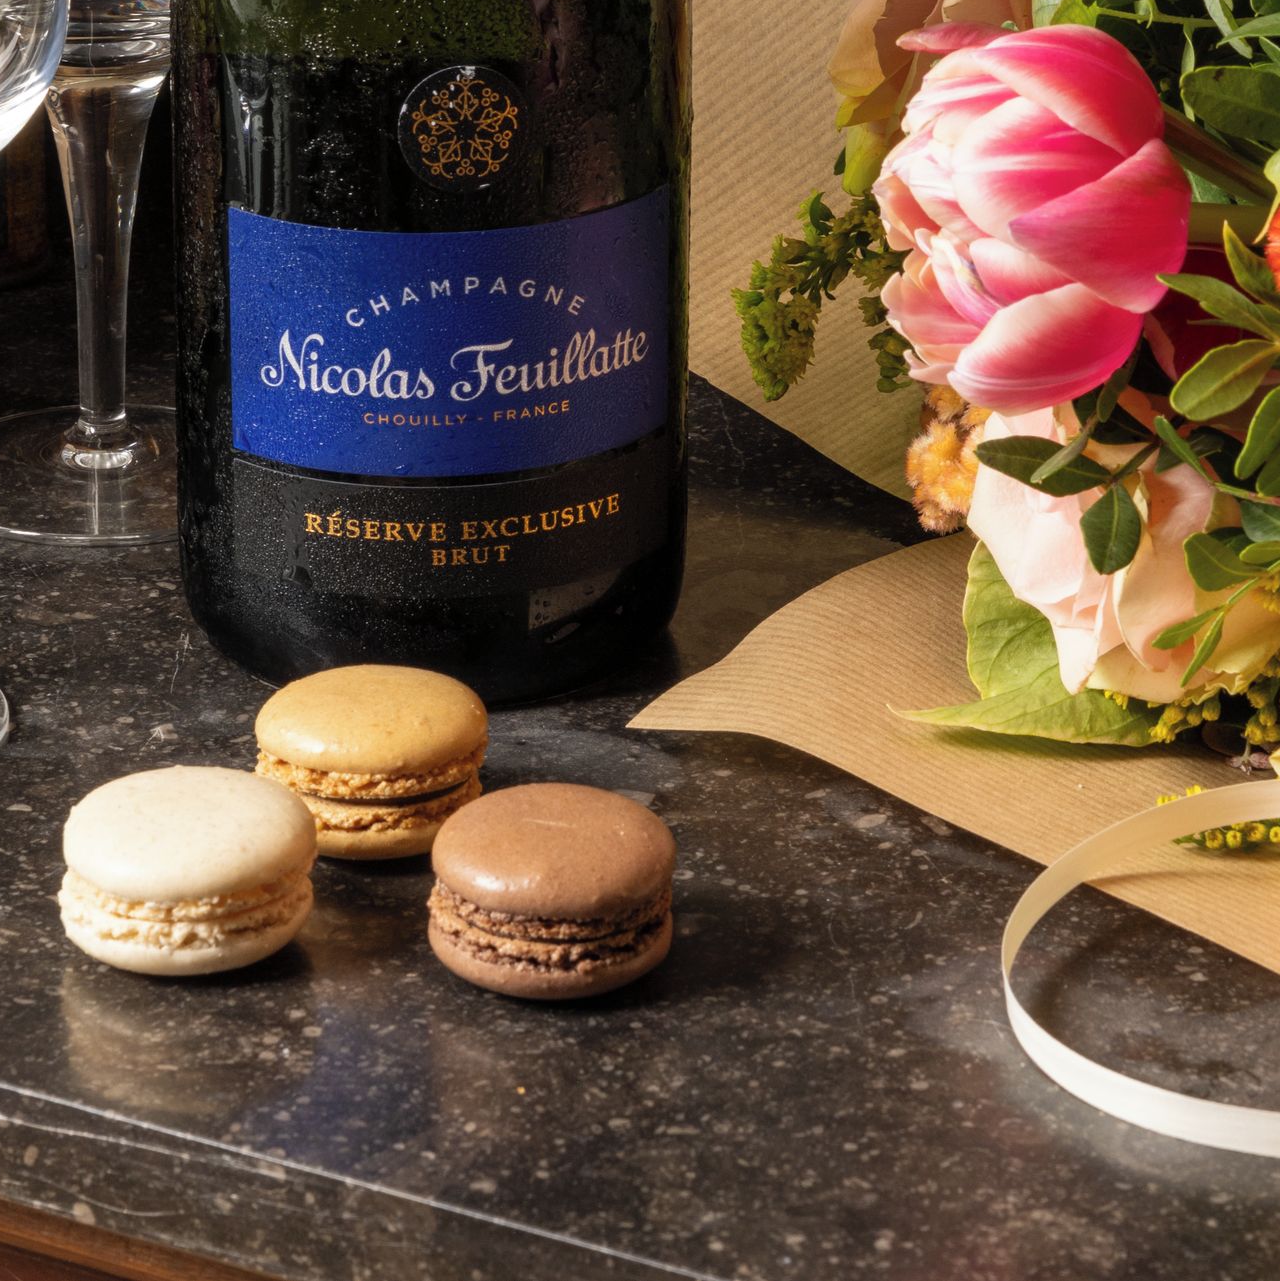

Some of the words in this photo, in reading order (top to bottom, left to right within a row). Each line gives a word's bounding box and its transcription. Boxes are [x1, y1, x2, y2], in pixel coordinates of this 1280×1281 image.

[344, 275, 588, 328] CHAMPAGNE
[260, 327, 436, 400] Nicolas
[450, 325, 650, 402] Feuillatte
[362, 410, 467, 427] CHOUILLY
[493, 399, 571, 421] FRANCE
[303, 510, 448, 543] RÉSERVE
[460, 492, 621, 542] EXCLUSIVE
[430, 544, 512, 567] BRUT
